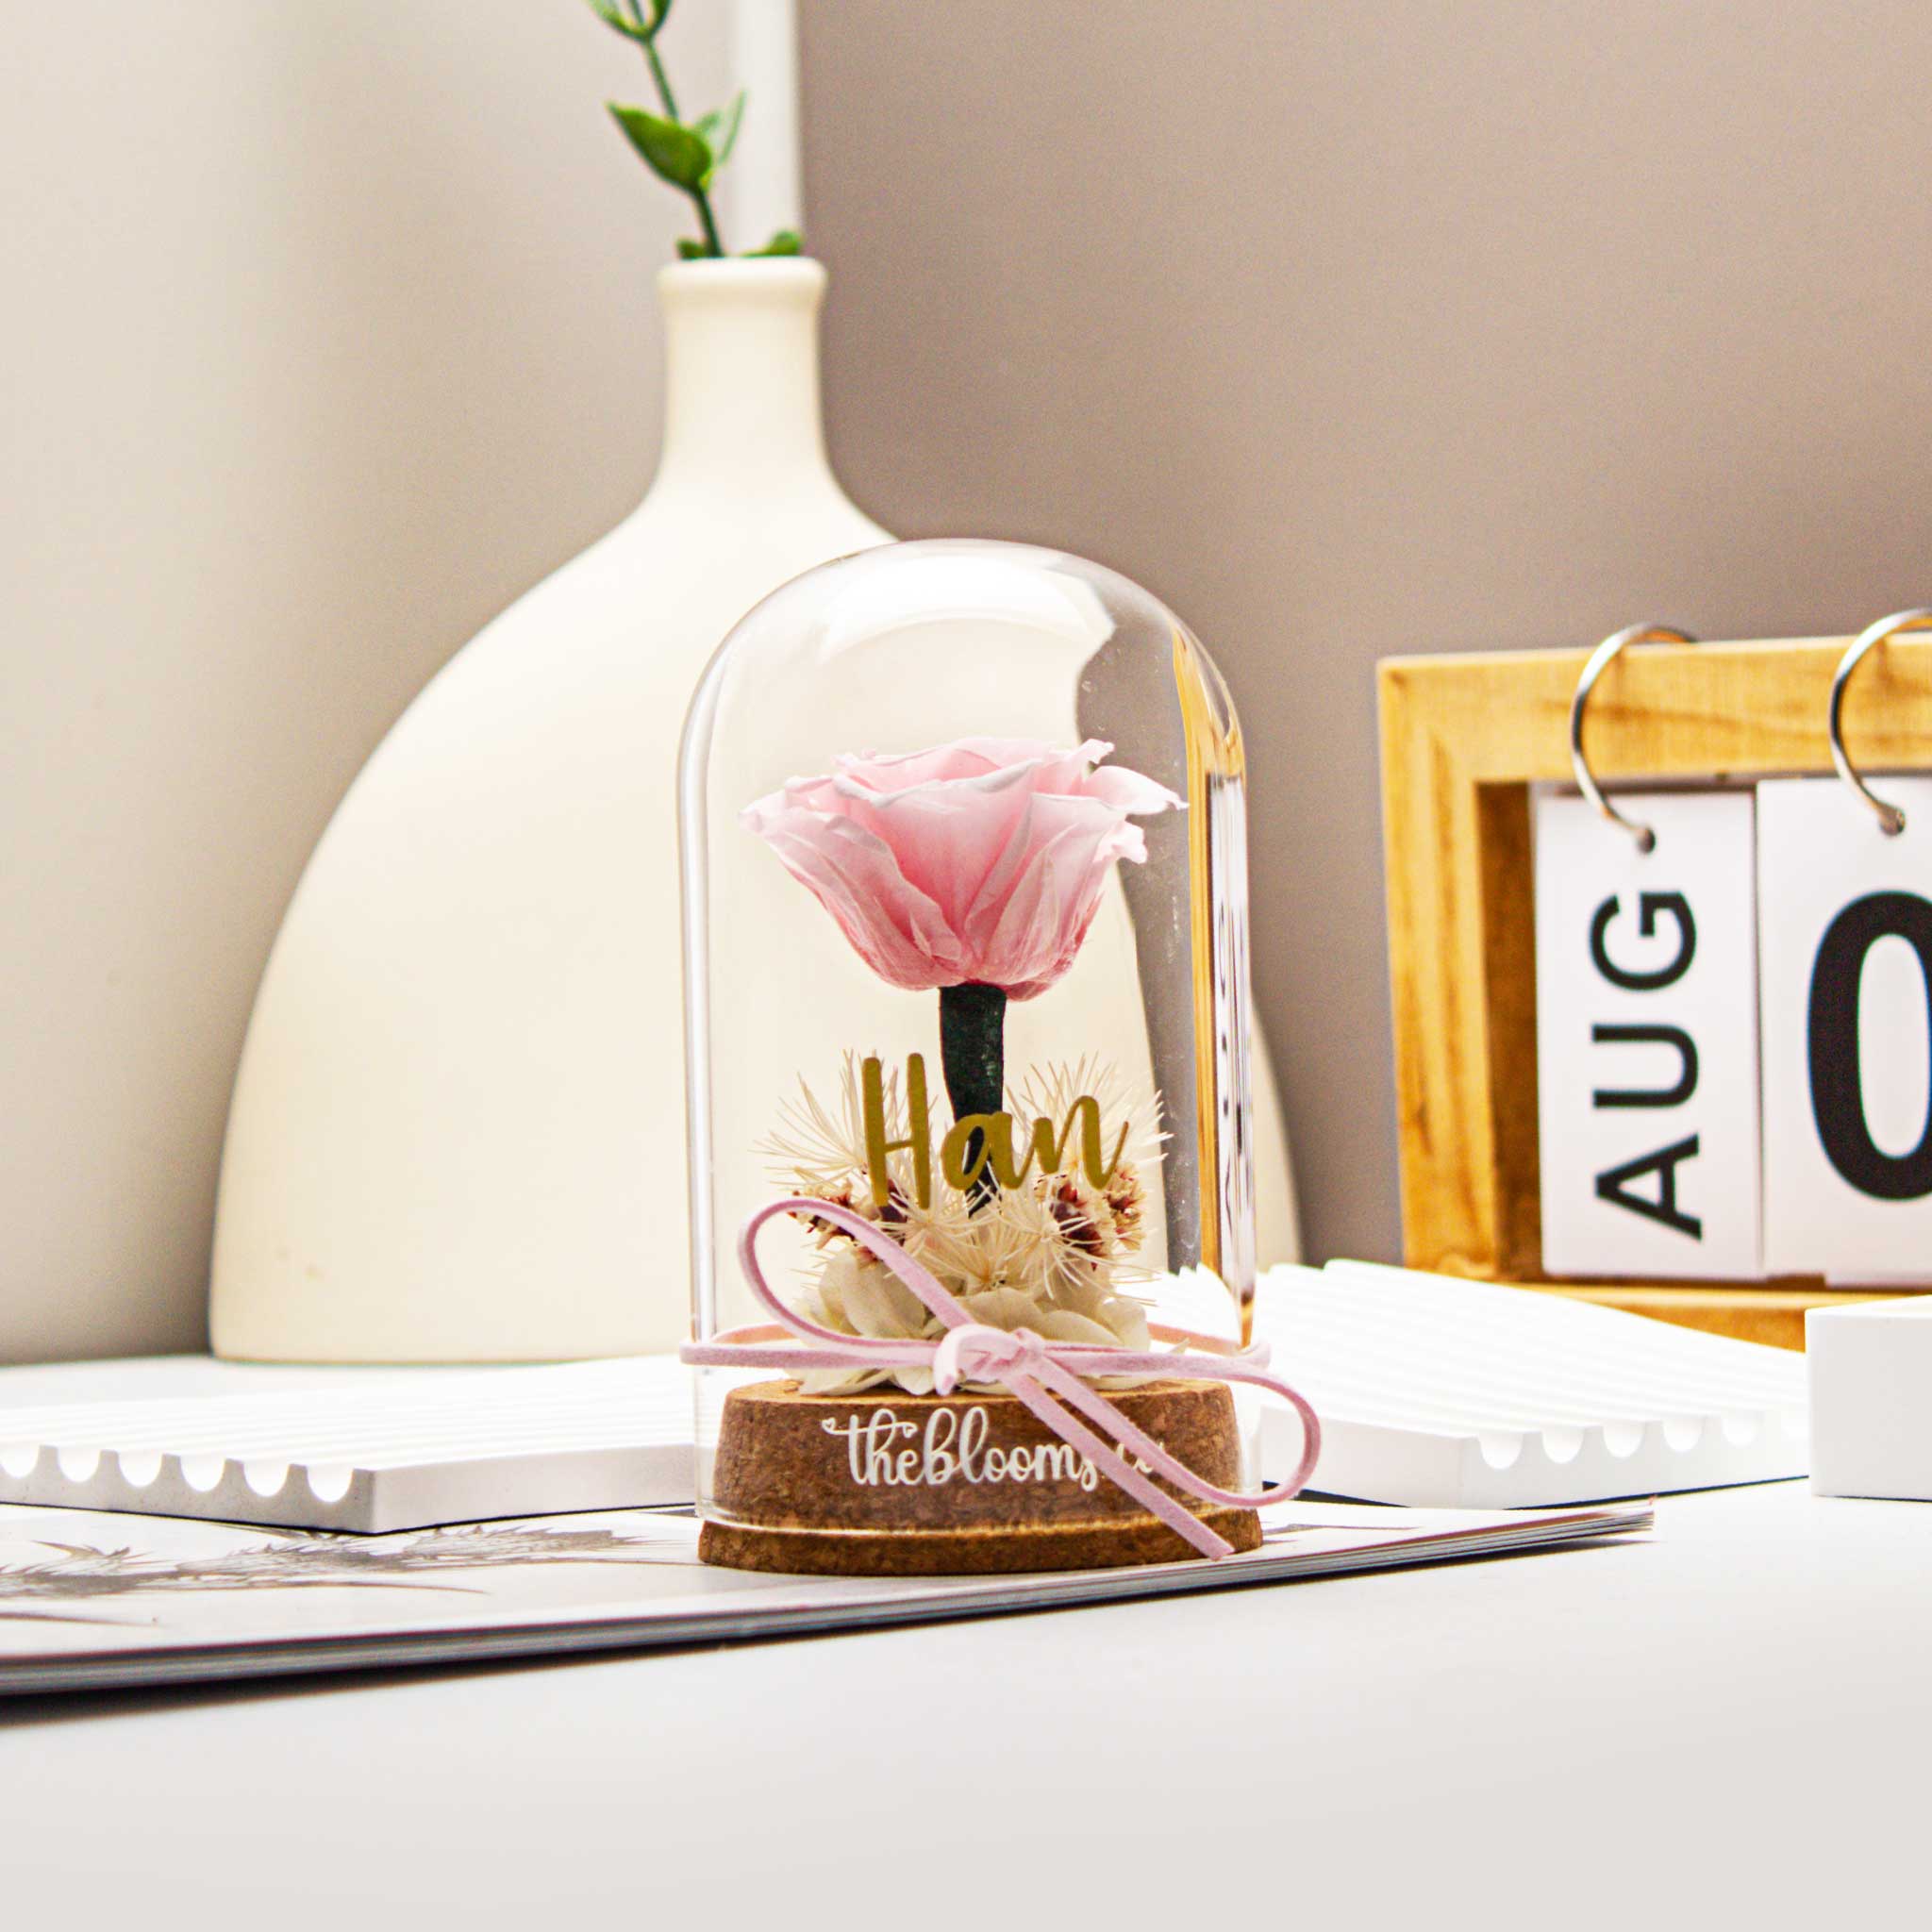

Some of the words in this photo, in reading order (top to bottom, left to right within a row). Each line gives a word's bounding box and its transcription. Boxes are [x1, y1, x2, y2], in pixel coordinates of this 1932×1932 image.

[862, 1053, 1129, 1210] Han
[1589, 891, 1702, 1241] AUG
[821, 1406, 1164, 1492] theblooms
